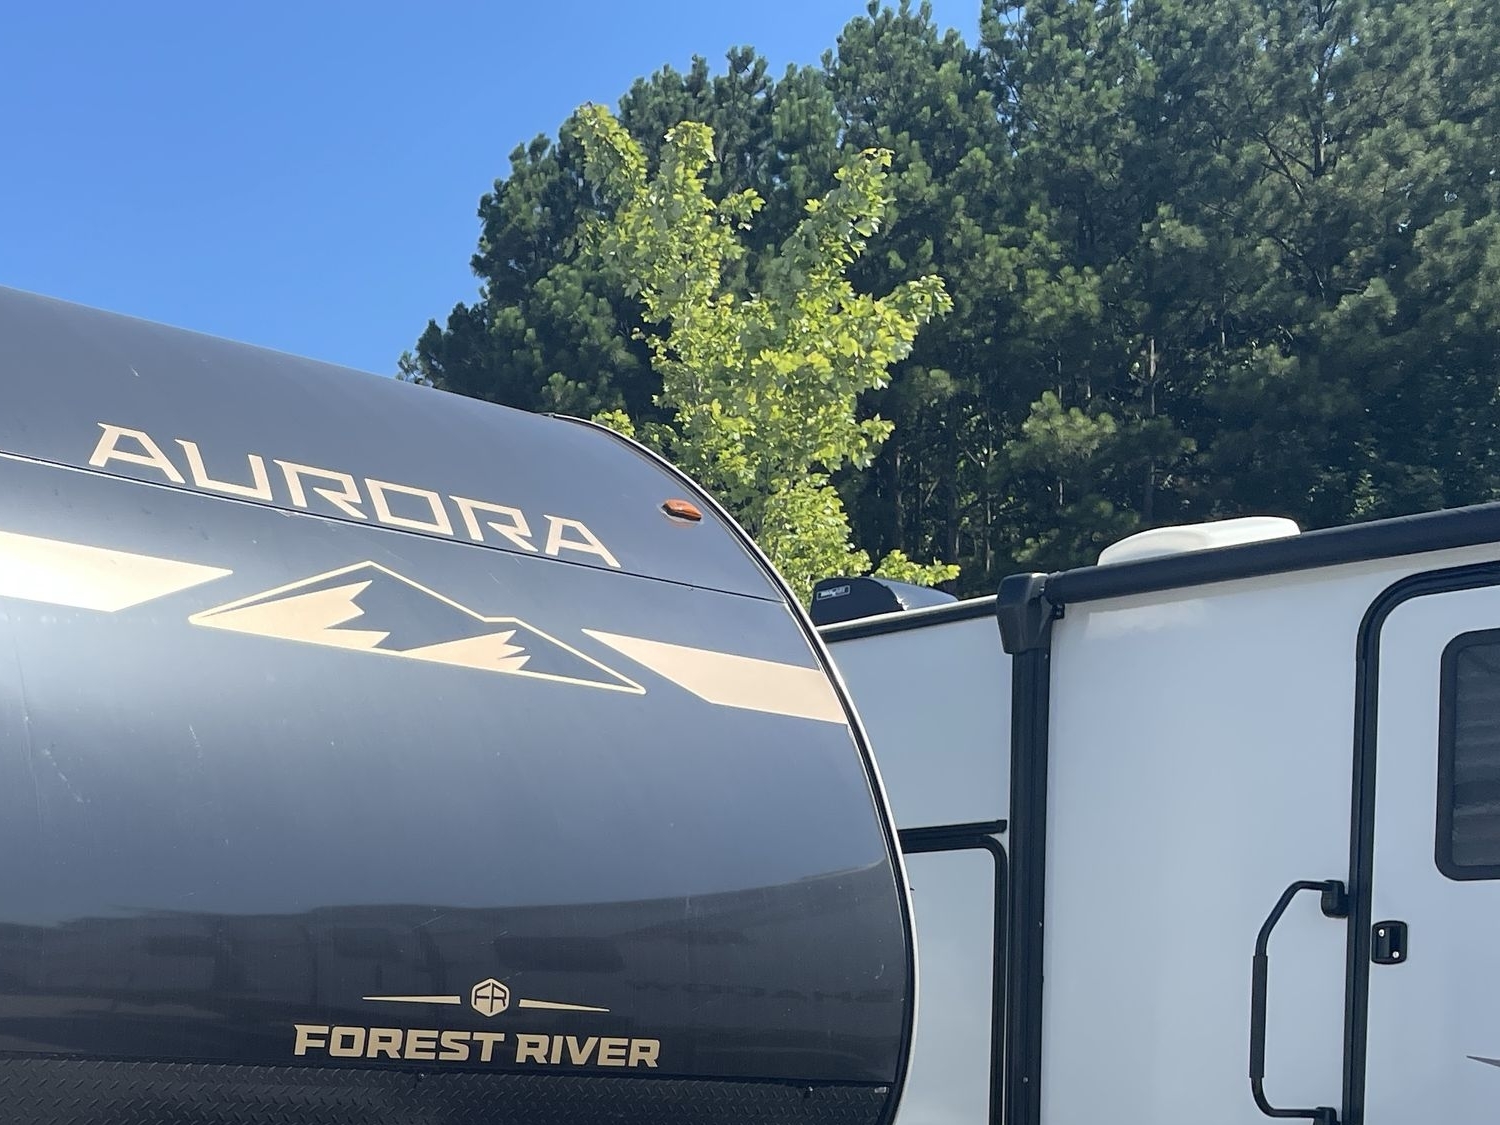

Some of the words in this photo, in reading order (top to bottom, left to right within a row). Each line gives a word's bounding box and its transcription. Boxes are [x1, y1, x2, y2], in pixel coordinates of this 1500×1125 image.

[88, 422, 621, 568] AURORA
[293, 1024, 505, 1062] FOREST
[515, 1033, 661, 1068] RIVER
